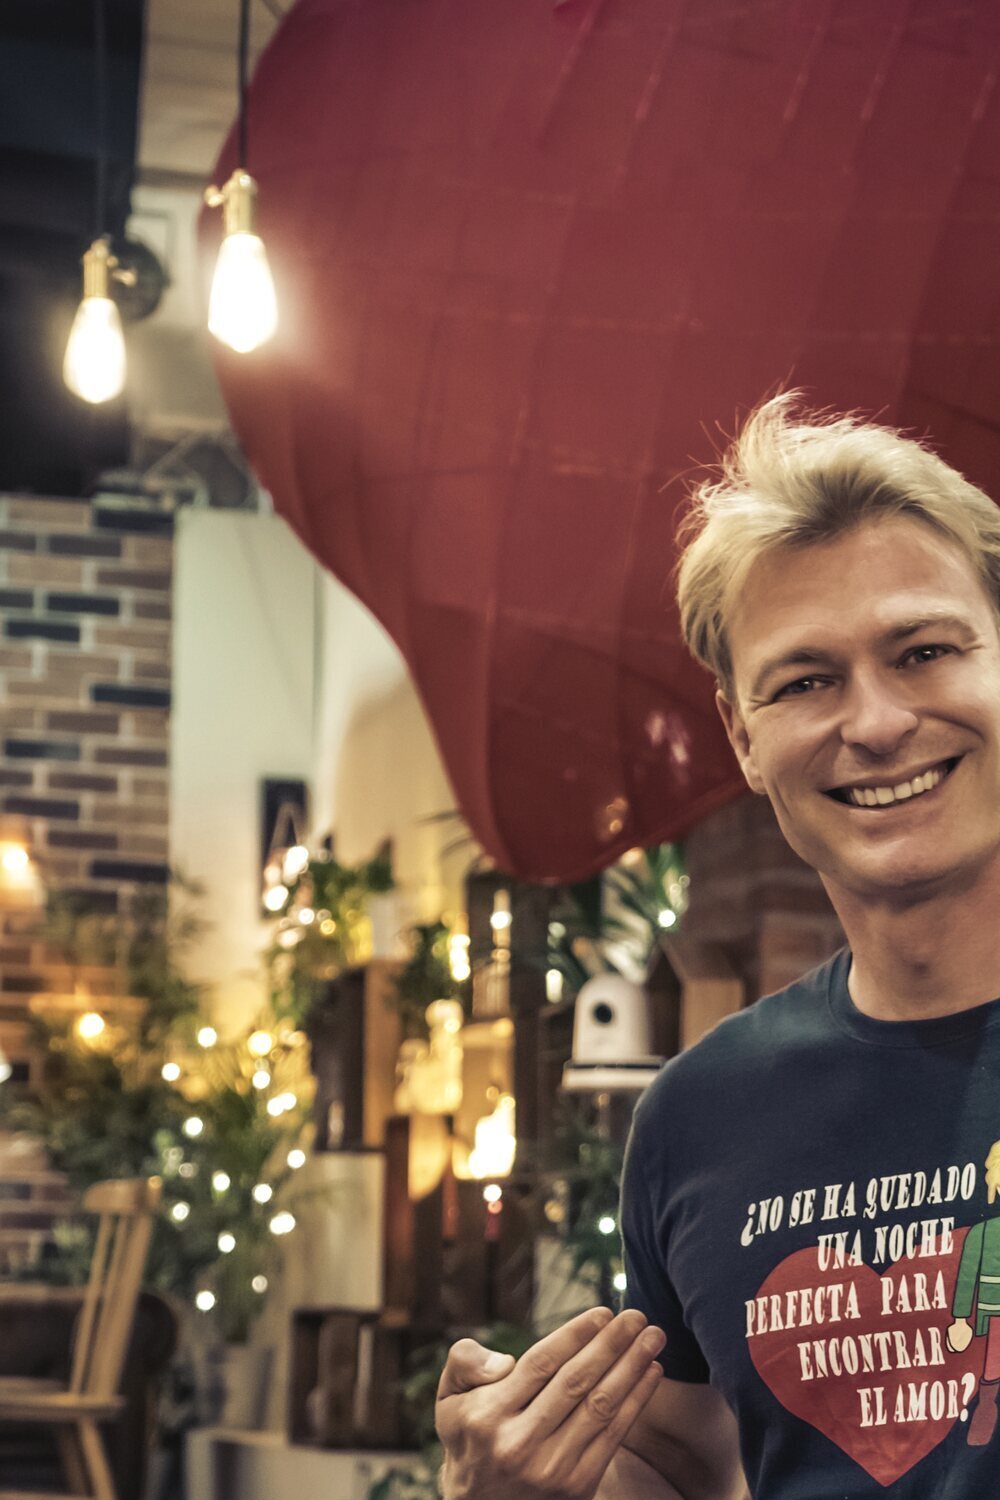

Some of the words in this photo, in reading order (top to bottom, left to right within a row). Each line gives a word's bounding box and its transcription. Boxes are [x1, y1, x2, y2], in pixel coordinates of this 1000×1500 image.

[740, 1195, 784, 1247] ¿NO
[789, 1188, 817, 1228] SE
[821, 1181, 857, 1221] HA
[863, 1162, 977, 1219] QUEDADO
[817, 1229, 863, 1272] UNA
[872, 1216, 955, 1264] NOCHE
[744, 1281, 861, 1338] PERFECTA
[880, 1270, 948, 1316] PARA
[797, 1327, 946, 1381] ENCONTRAR
[857, 1387, 888, 1427] EL
[893, 1372, 976, 1422] AMOR?
